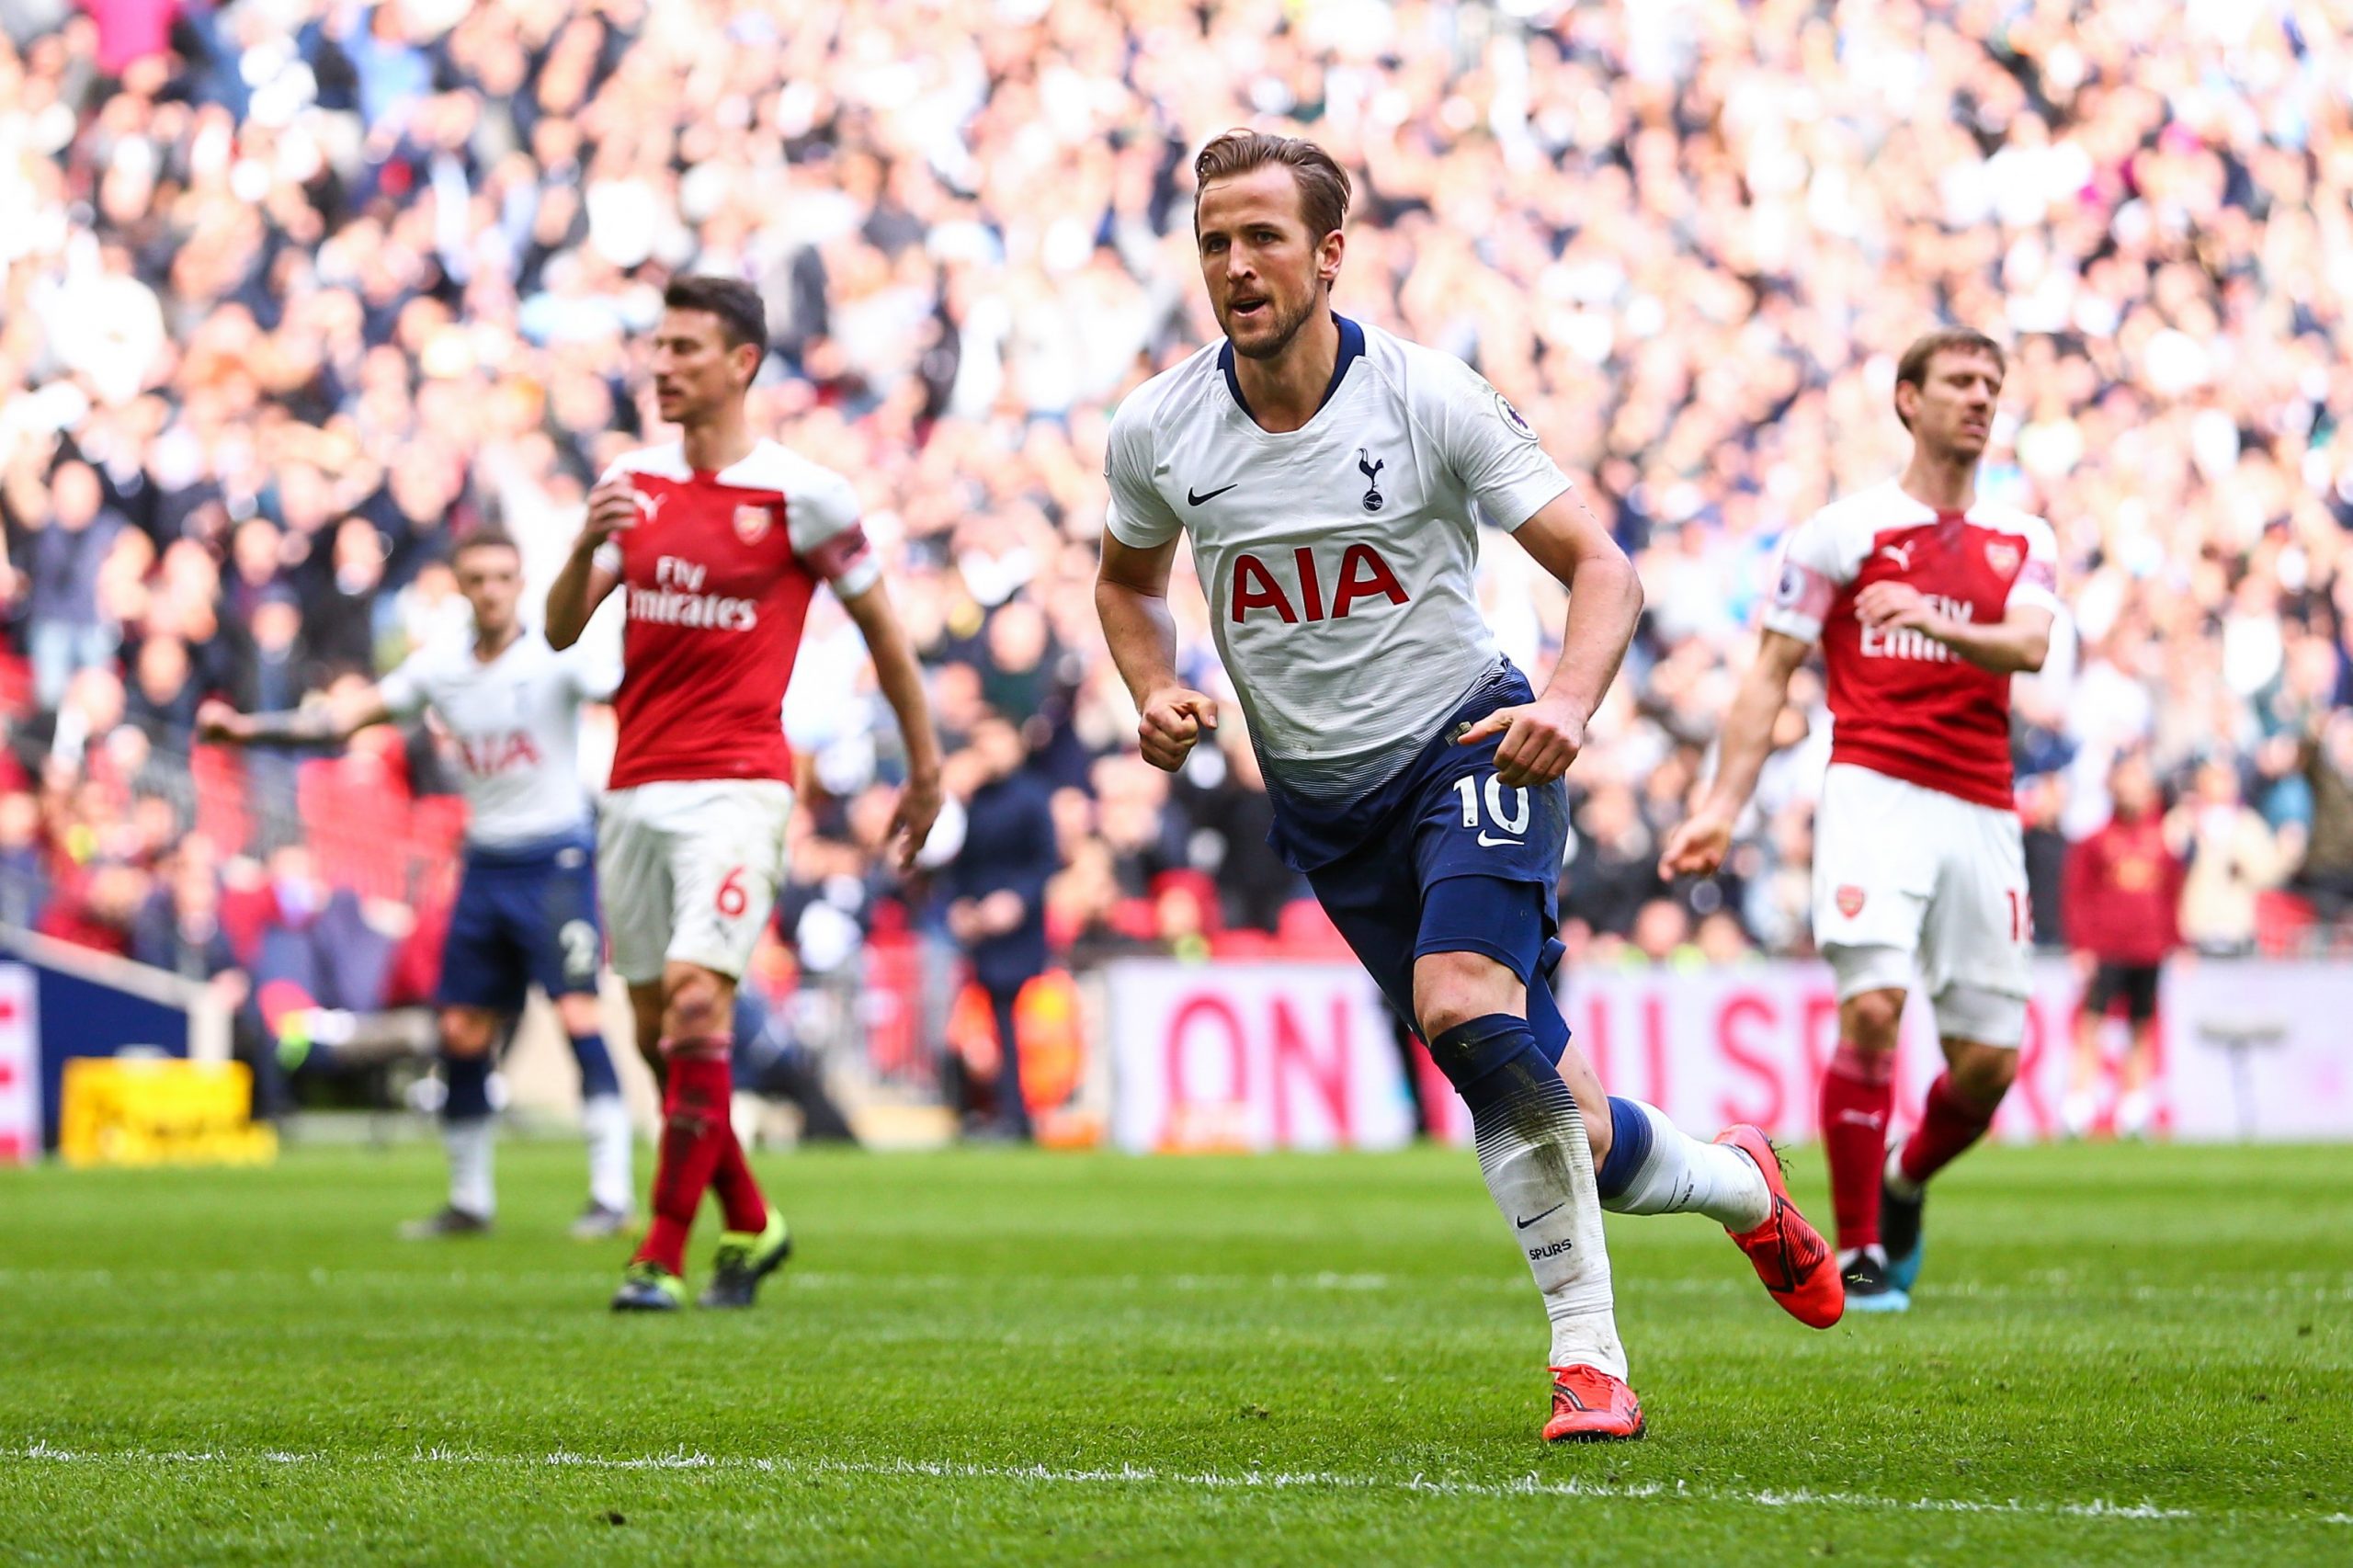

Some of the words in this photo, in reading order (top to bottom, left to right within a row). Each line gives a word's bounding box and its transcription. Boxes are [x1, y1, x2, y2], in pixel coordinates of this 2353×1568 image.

[655, 555, 708, 593] Fly
[1232, 544, 1410, 624] AIA
[627, 579, 758, 632] mirates
[1452, 771, 1530, 835] 10
[717, 865, 747, 917] 6
[558, 919, 599, 980] 2
[1162, 994, 1351, 1143] ON
[1529, 1238, 1573, 1260] SPURS
